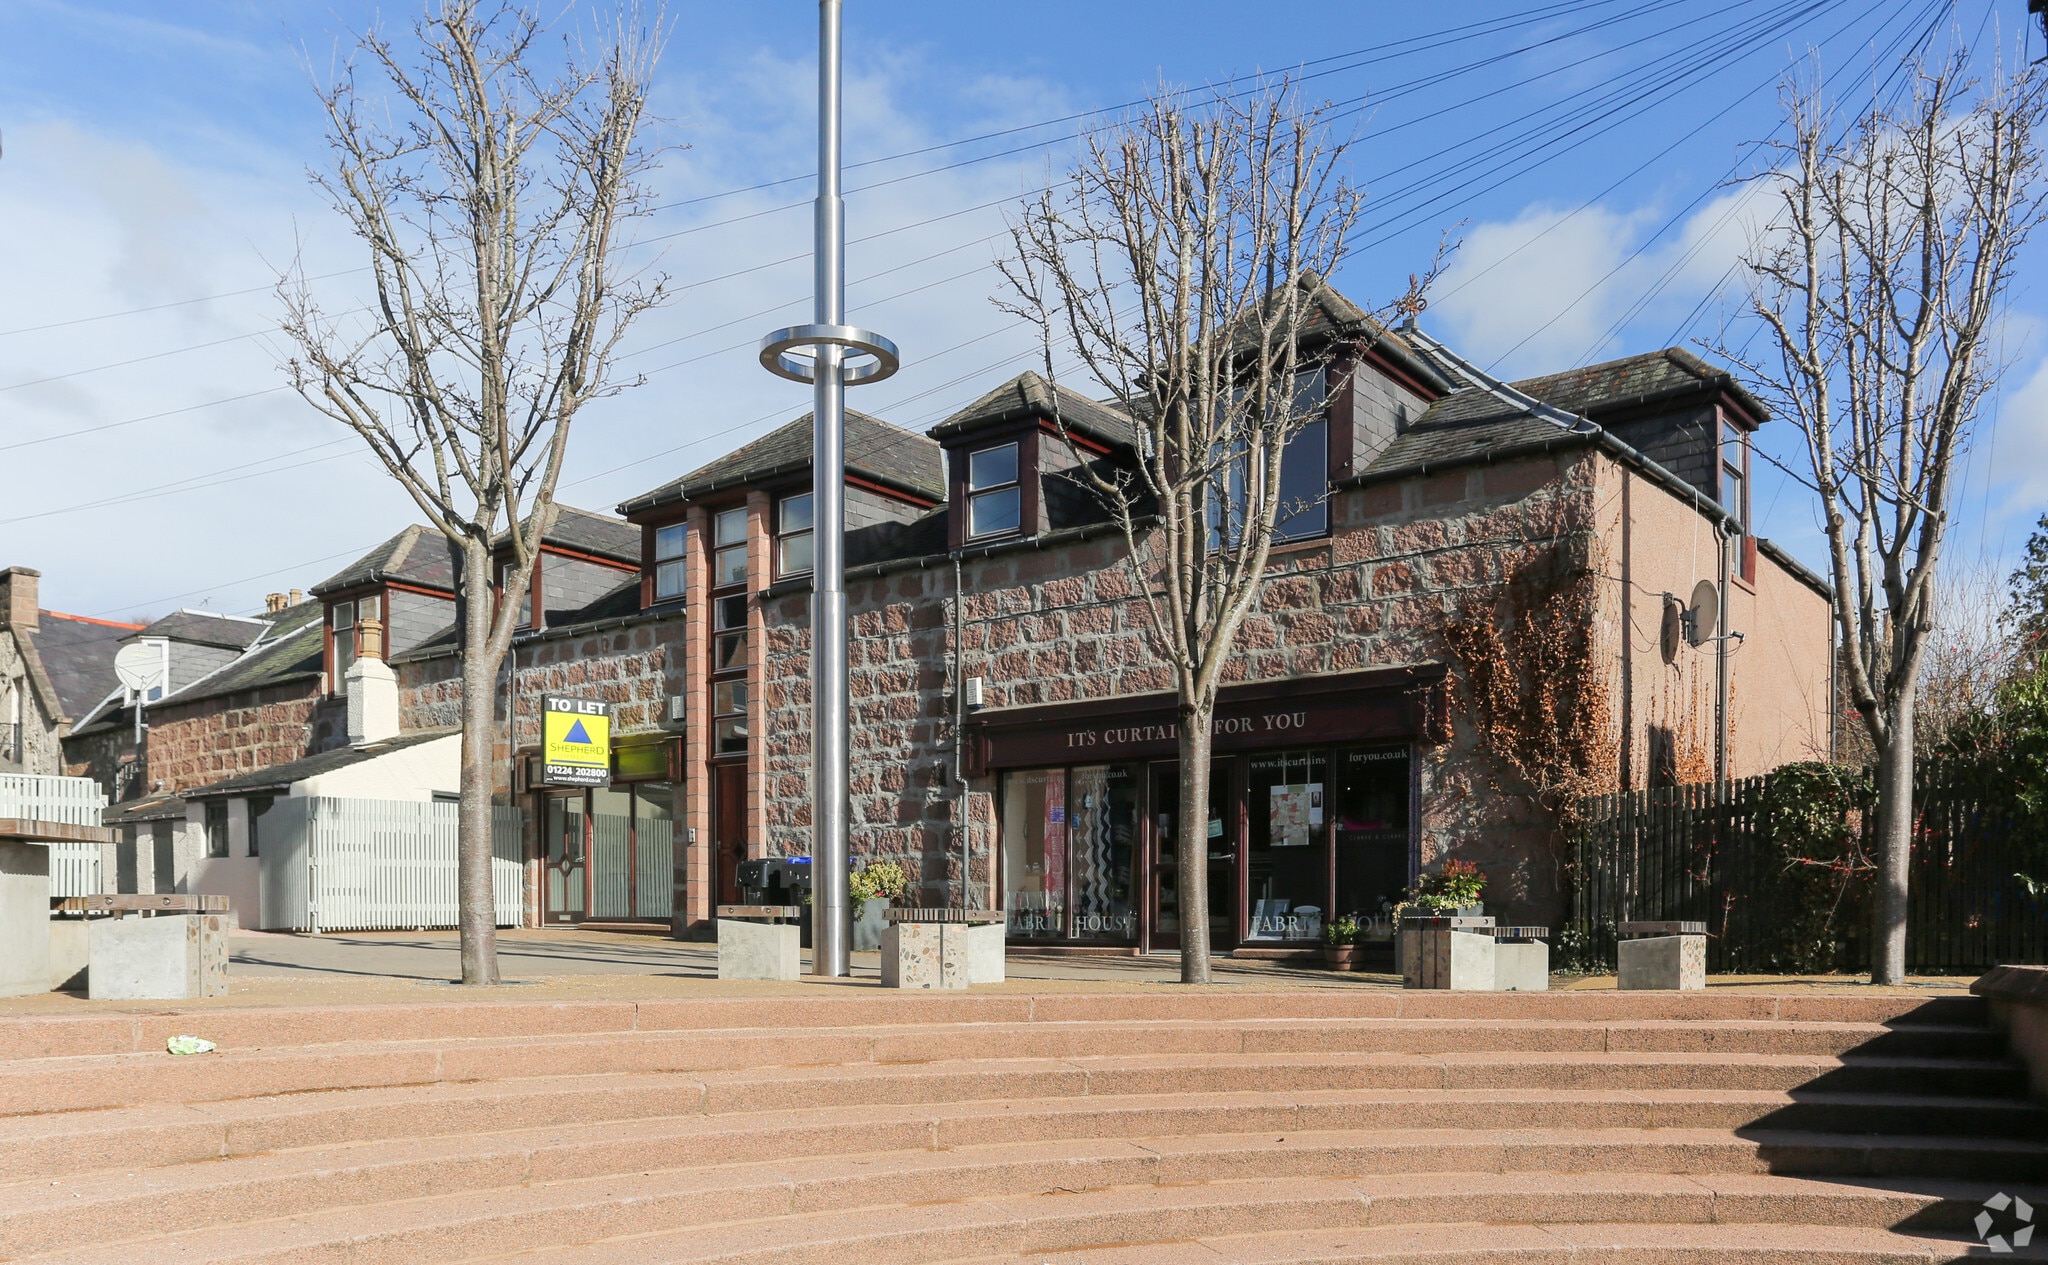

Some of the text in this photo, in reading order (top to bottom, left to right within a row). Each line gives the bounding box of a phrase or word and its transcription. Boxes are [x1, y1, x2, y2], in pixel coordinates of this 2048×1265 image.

[548, 698, 606, 715] TO LET
[1067, 712, 1307, 747] IT'S CURTAI FOR YOU
[550, 742, 604, 755] SHEPHERD
[1349, 749, 1408, 764] foryou.co.uk
[547, 765, 606, 777] 01224 202800
